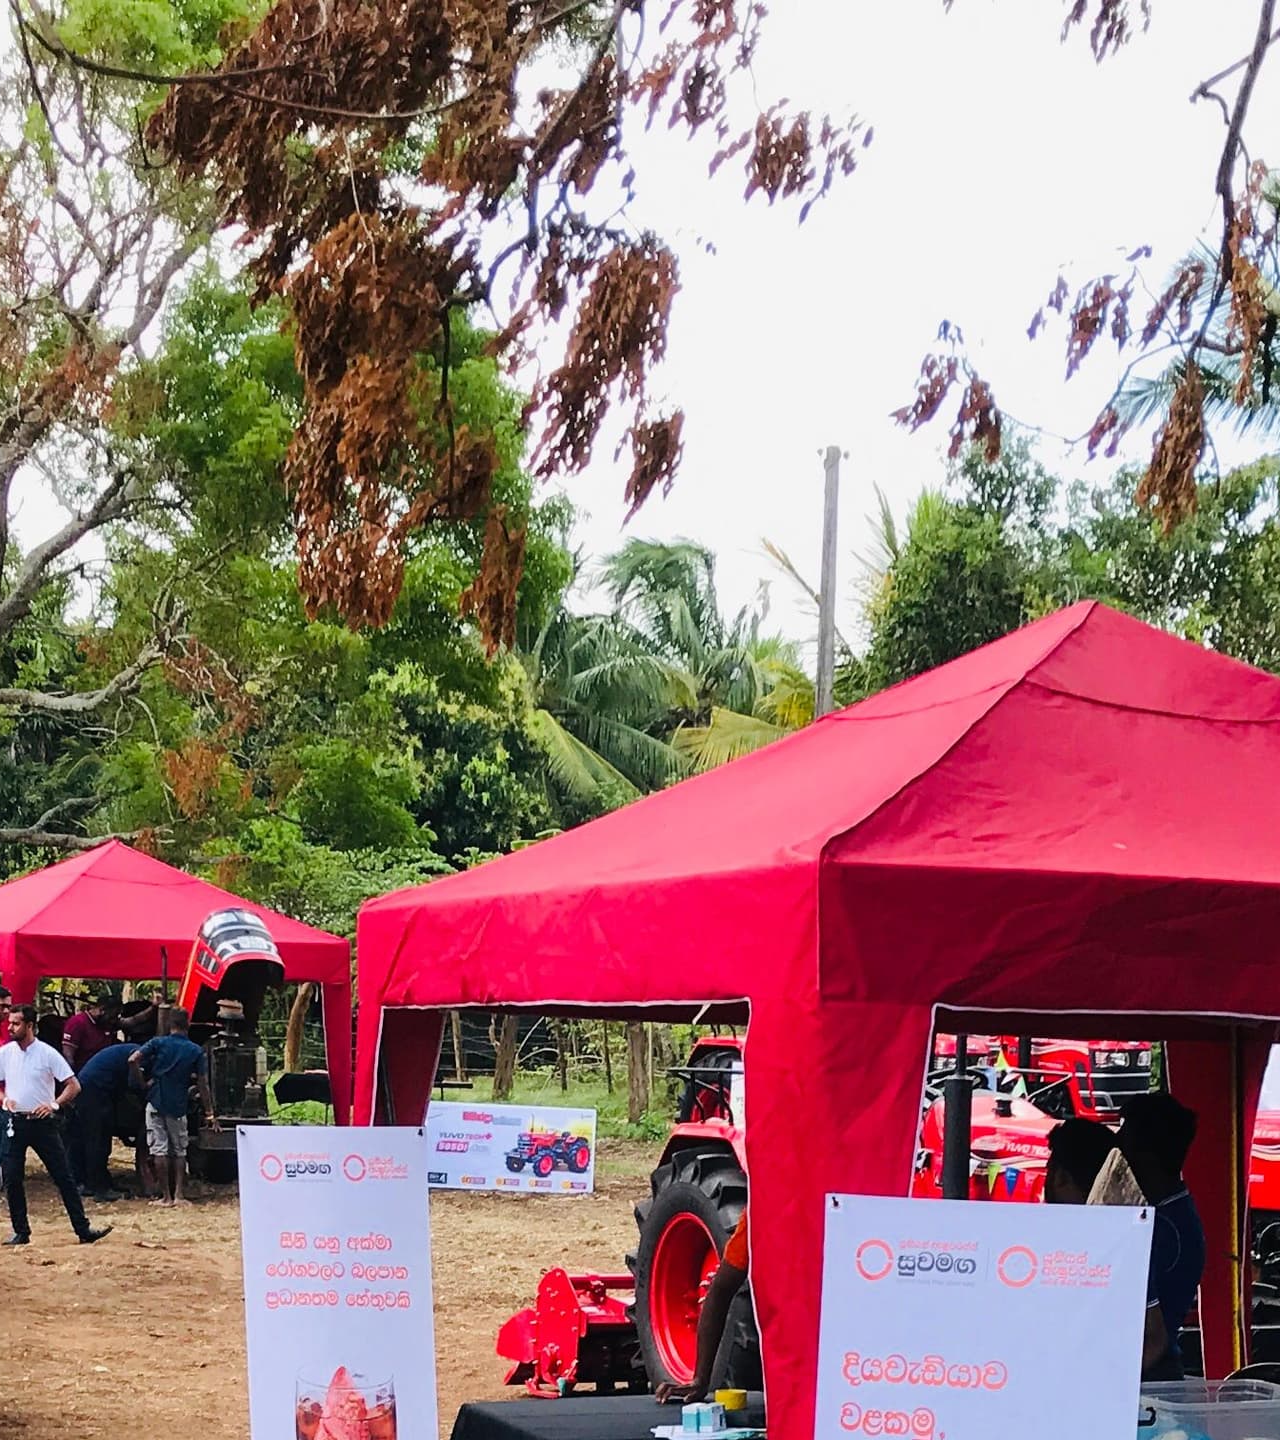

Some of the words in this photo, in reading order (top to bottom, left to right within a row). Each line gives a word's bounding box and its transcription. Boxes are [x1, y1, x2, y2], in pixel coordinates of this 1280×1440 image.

[314, 1236, 340, 1253] යනු
[347, 1232, 393, 1252] අක්මා
[266, 1259, 346, 1281] රෝගවලට
[842, 1351, 1009, 1391] දියවැඩියාව
